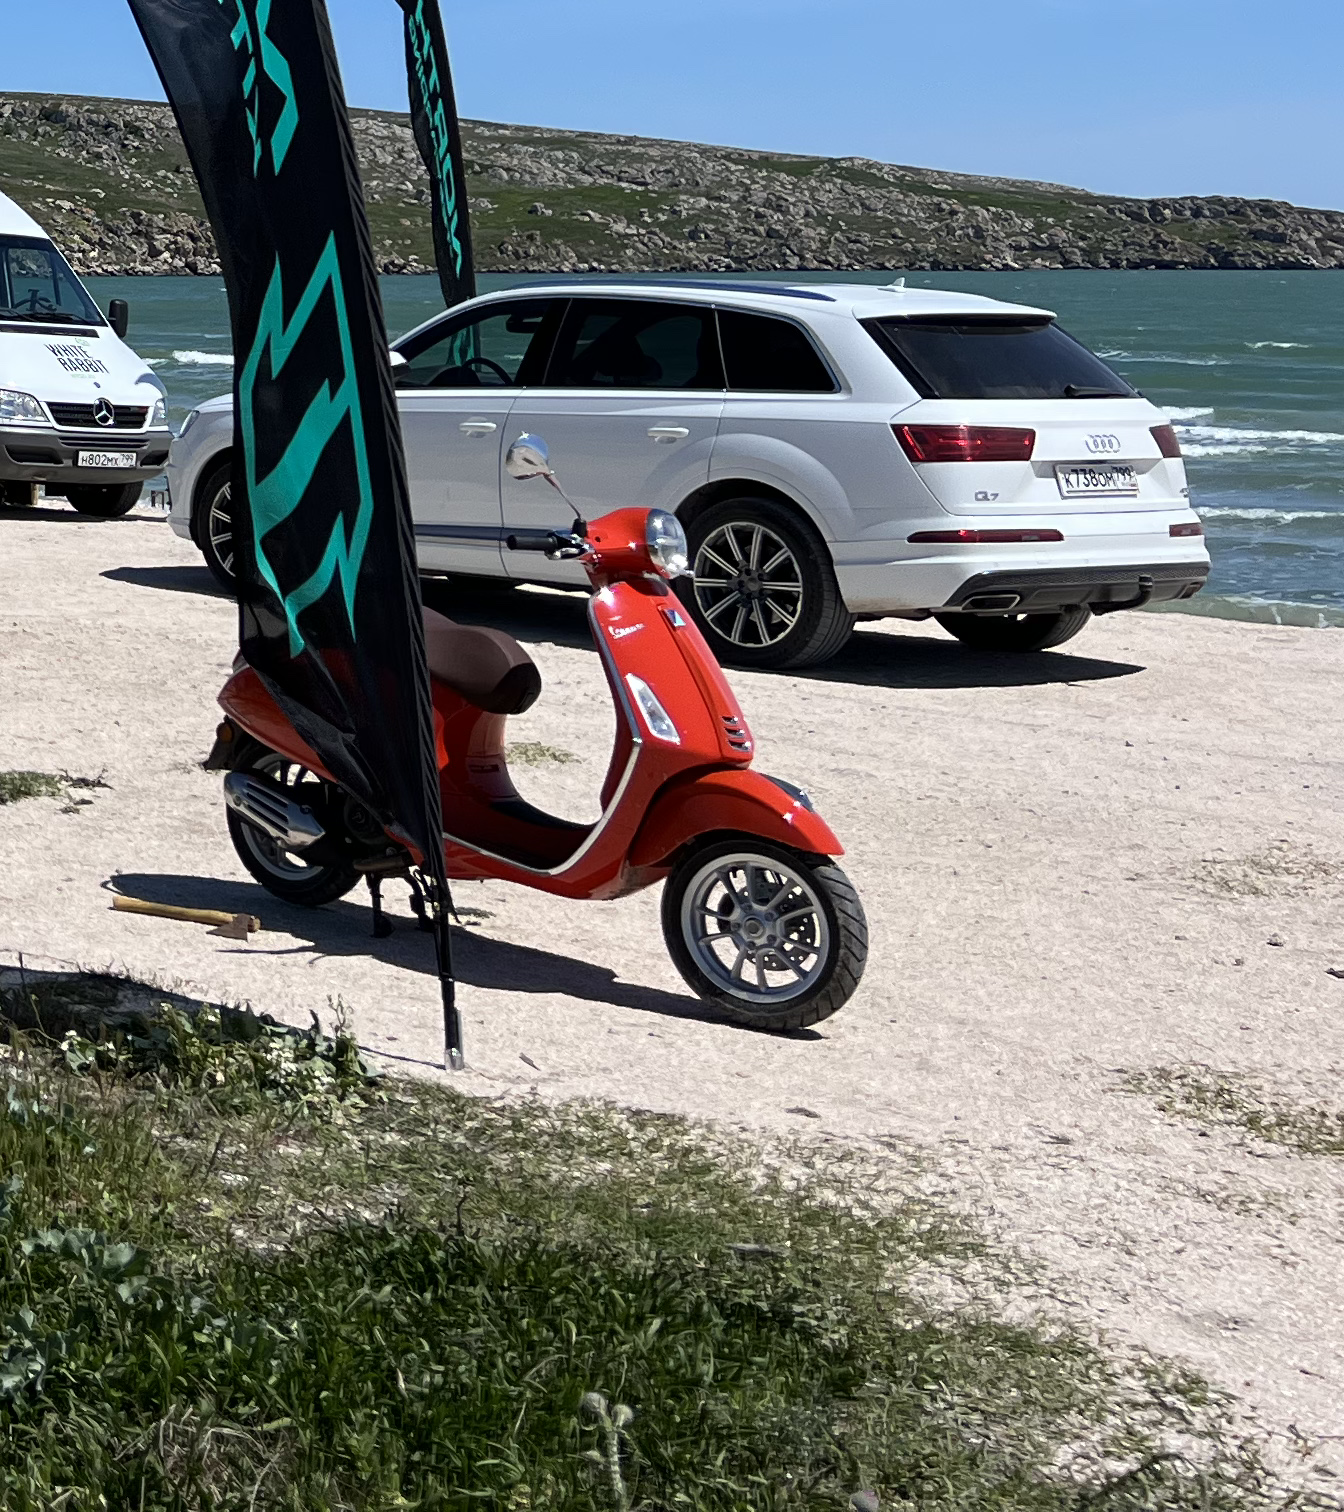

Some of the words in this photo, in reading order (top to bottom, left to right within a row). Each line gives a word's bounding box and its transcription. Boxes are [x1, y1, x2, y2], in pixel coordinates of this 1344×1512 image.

[44, 344, 93, 359] WHITE
[57, 357, 110, 374] RABBIT
[974, 491, 1000, 502] Q7
